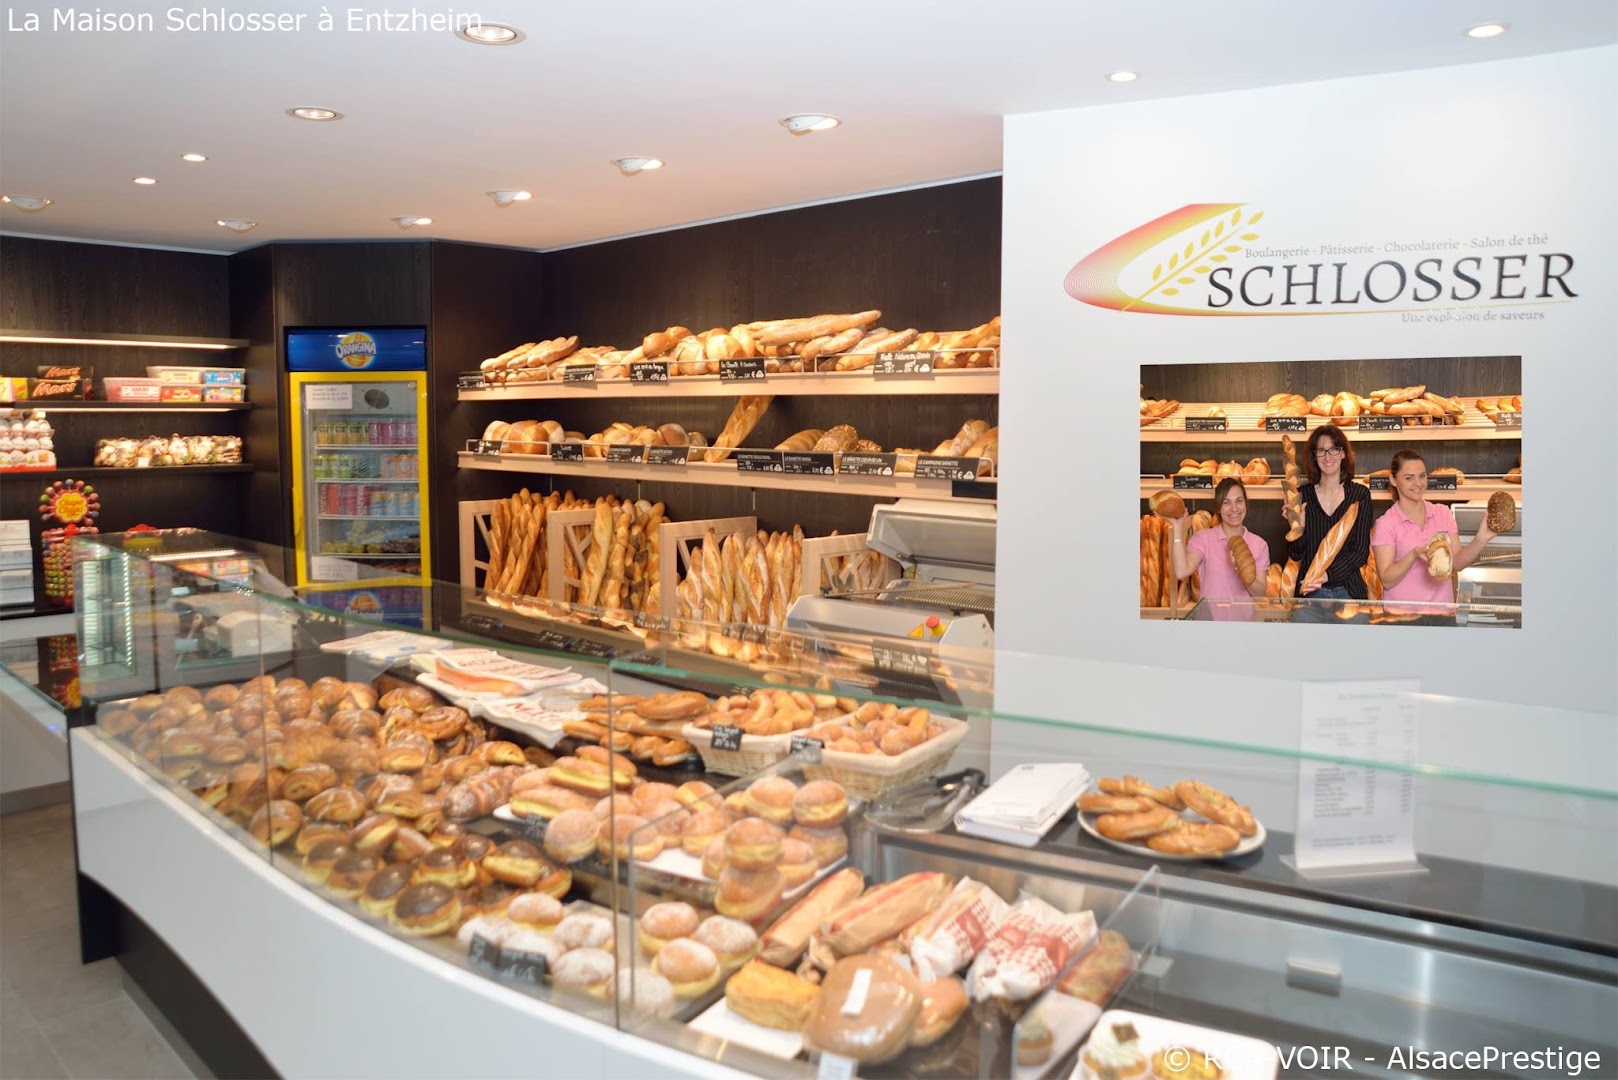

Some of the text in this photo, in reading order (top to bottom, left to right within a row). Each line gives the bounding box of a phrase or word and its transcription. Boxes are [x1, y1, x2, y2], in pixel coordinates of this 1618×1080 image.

[1245, 245, 1310, 260] Boulangerie
[1320, 241, 1375, 257] Pâtisserie
[1384, 238, 1460, 254] Chocolaterie
[1470, 236, 1504, 250] Salon
[1508, 234, 1524, 247] de
[1526, 232, 1549, 246] thé
[1207, 253, 1578, 308] SCHLOSSER
[1482, 309, 1498, 321] de
[1500, 310, 1545, 321] saveurs
[45, 366, 81, 378] Mars
[32, 381, 77, 397] Mars
